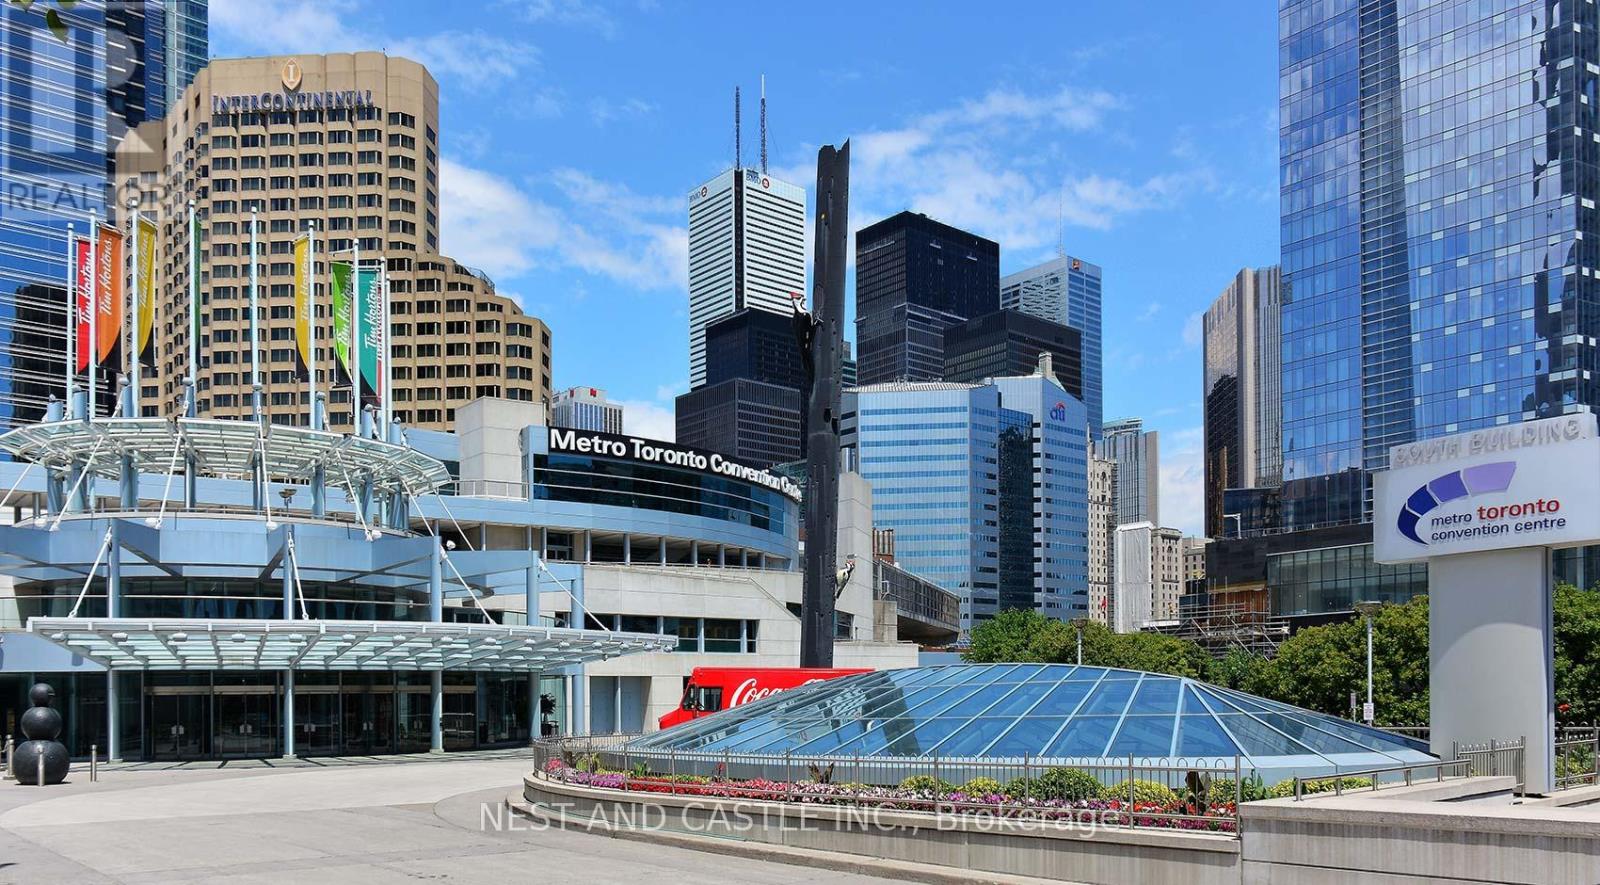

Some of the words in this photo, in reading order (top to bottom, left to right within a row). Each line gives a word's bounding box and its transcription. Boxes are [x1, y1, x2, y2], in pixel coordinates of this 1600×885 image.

[99, 290, 112, 316] Tim
[364, 278, 377, 327] Hortons
[364, 326, 377, 349] Tim
[1396, 438, 1459, 466] SOUTH
[1469, 418, 1581, 455] BUILDING
[550, 428, 627, 457] Metro
[630, 438, 708, 470] Toronto
[710, 453, 781, 490] Convention
[1431, 513, 1472, 527] metro
[1477, 498, 1560, 520] toronto
[1431, 523, 1509, 541] convention
[1515, 517, 1566, 532] centre
